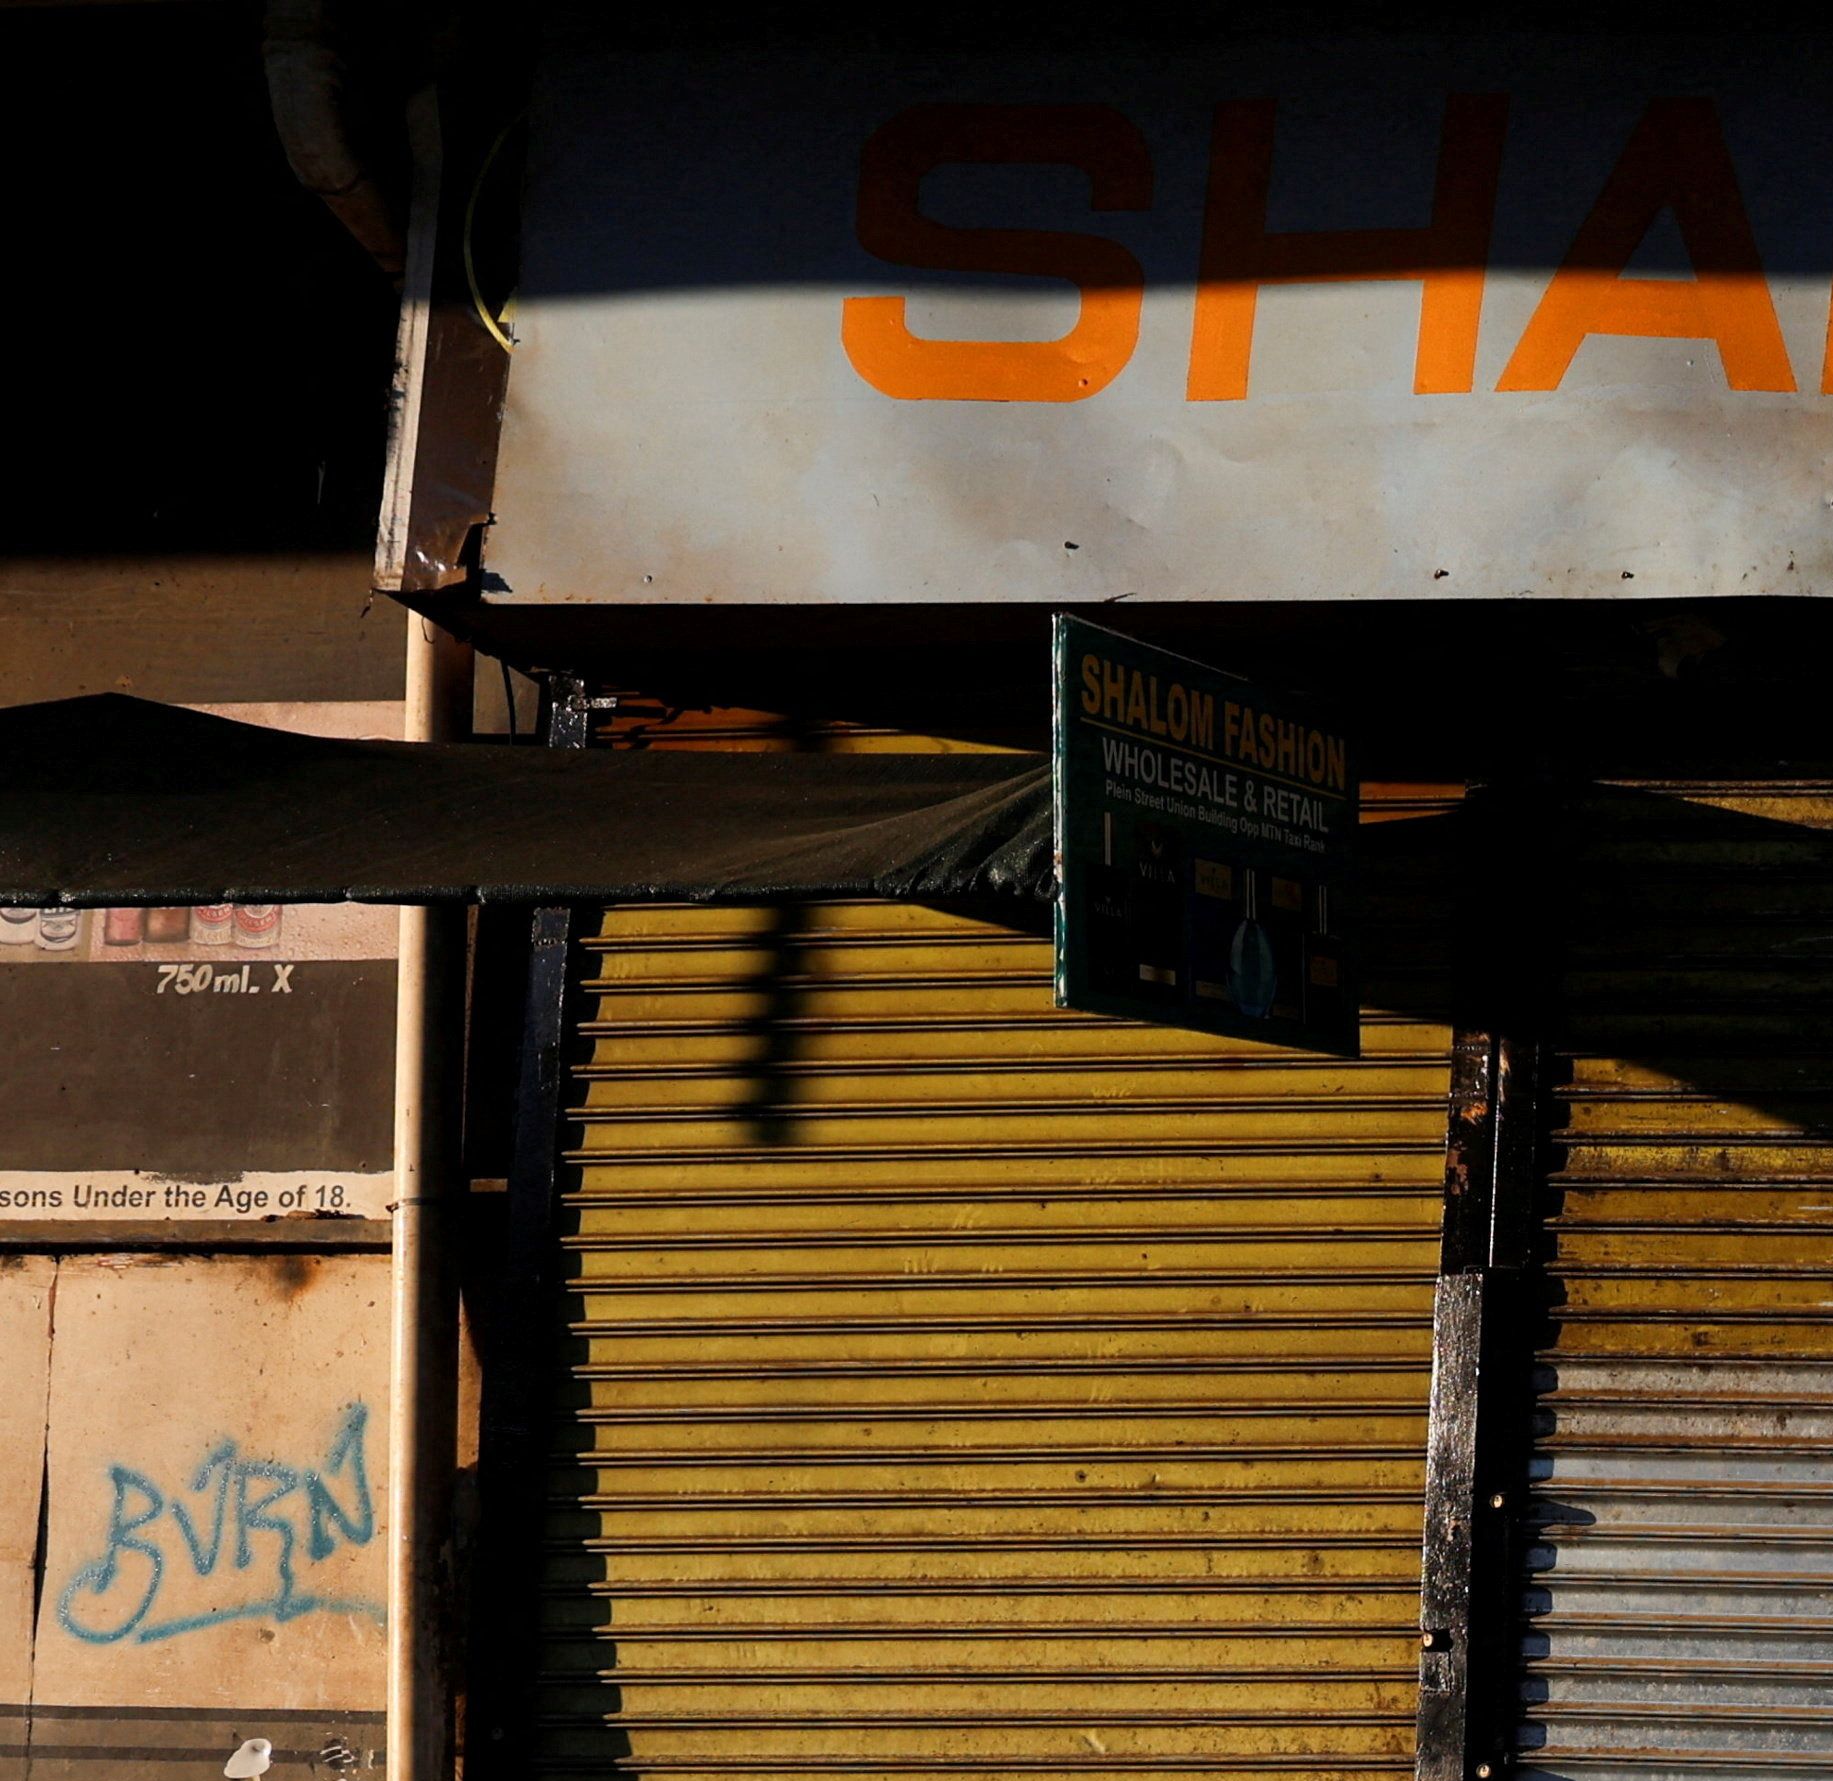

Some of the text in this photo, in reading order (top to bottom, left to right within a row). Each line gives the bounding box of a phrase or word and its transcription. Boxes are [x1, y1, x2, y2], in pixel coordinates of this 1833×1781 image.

[1080, 653, 1347, 792] SHALOM FASHION
[1102, 735, 1329, 833] WHOLESALE & RETAIL
[1134, 787, 1165, 811] Street
[1167, 797, 1196, 818] Union
[1198, 804, 1238, 833] Building
[1239, 816, 1260, 841] Opp
[271, 963, 293, 994] X
[0, 1185, 351, 1213] sons Under the Age of 18.
